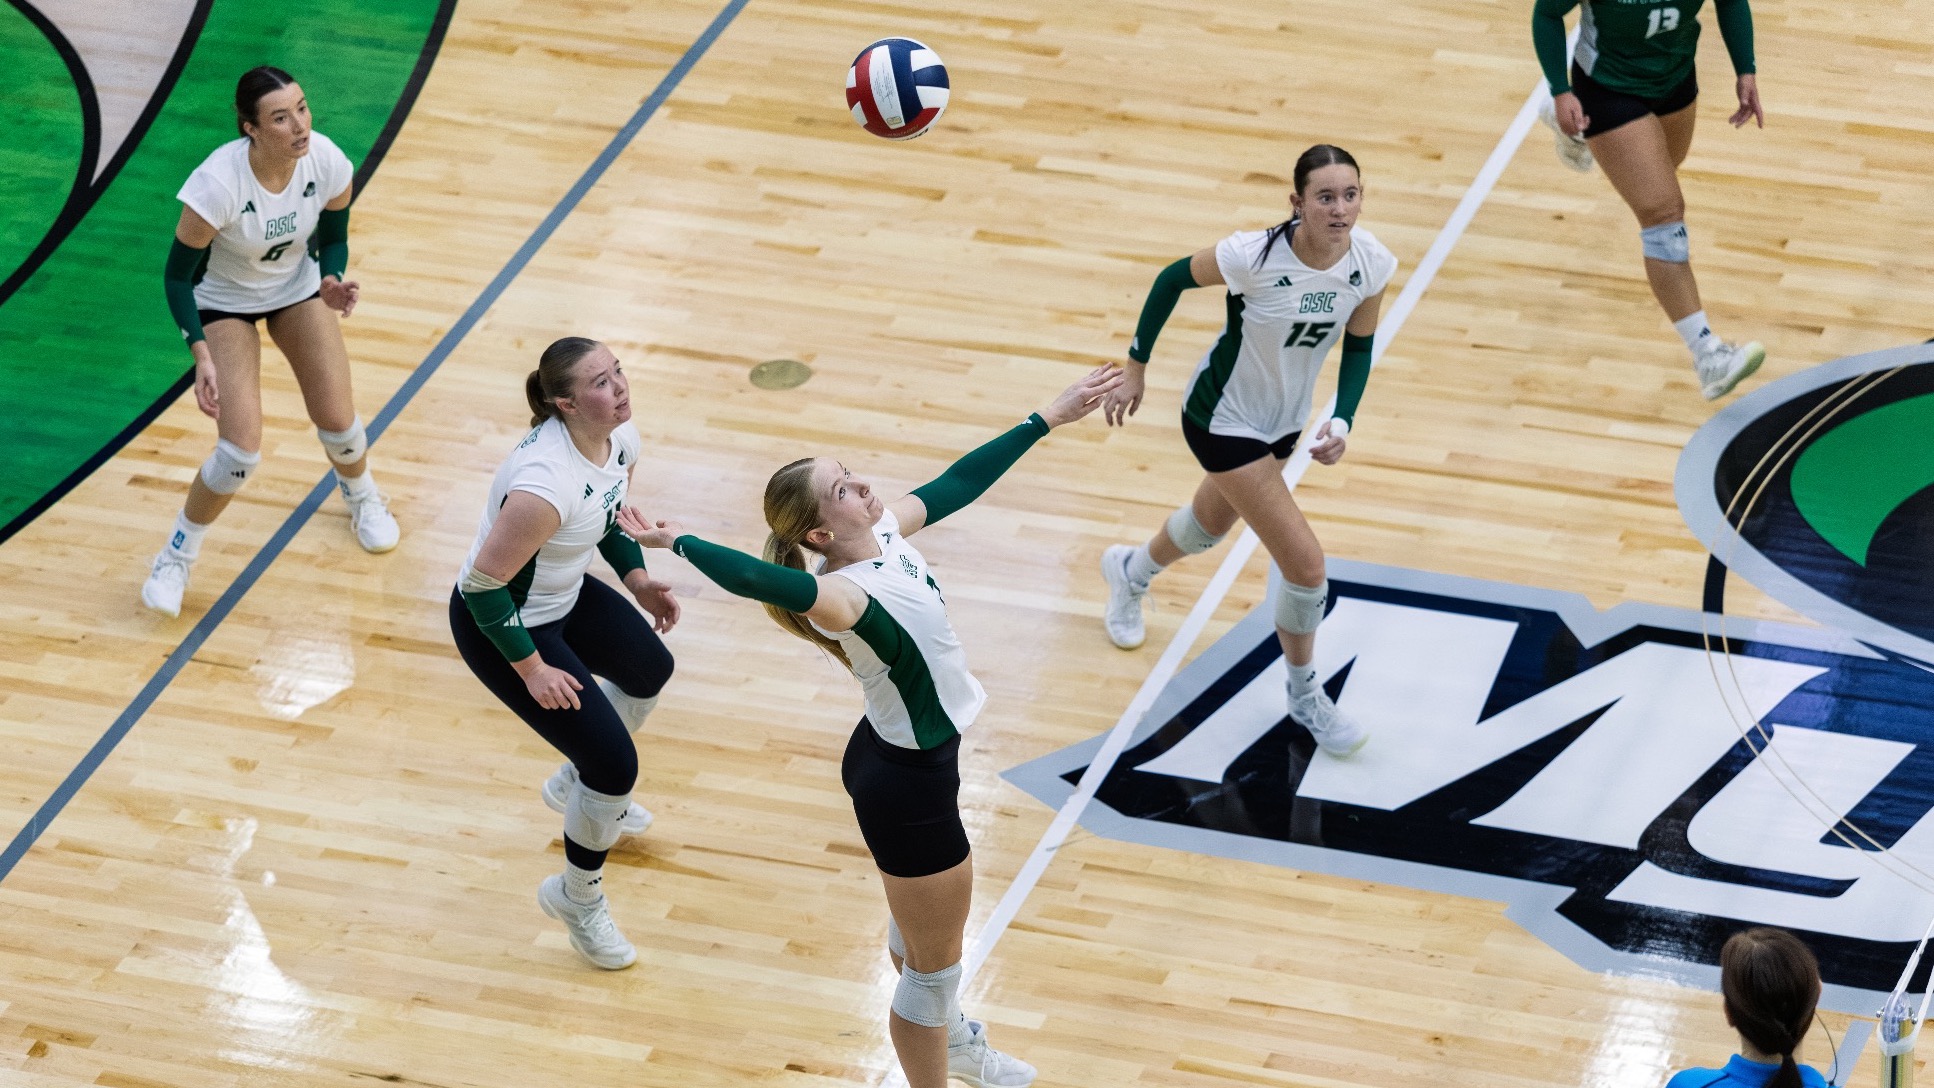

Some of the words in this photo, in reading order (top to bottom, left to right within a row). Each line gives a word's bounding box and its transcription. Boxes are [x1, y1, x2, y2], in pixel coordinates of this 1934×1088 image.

[1645, 7, 1680, 39] 13
[265, 211, 297, 241] BSC
[260, 240, 294, 262] 6
[1299, 292, 1337, 314] BSC
[1283, 321, 1337, 348] 15
